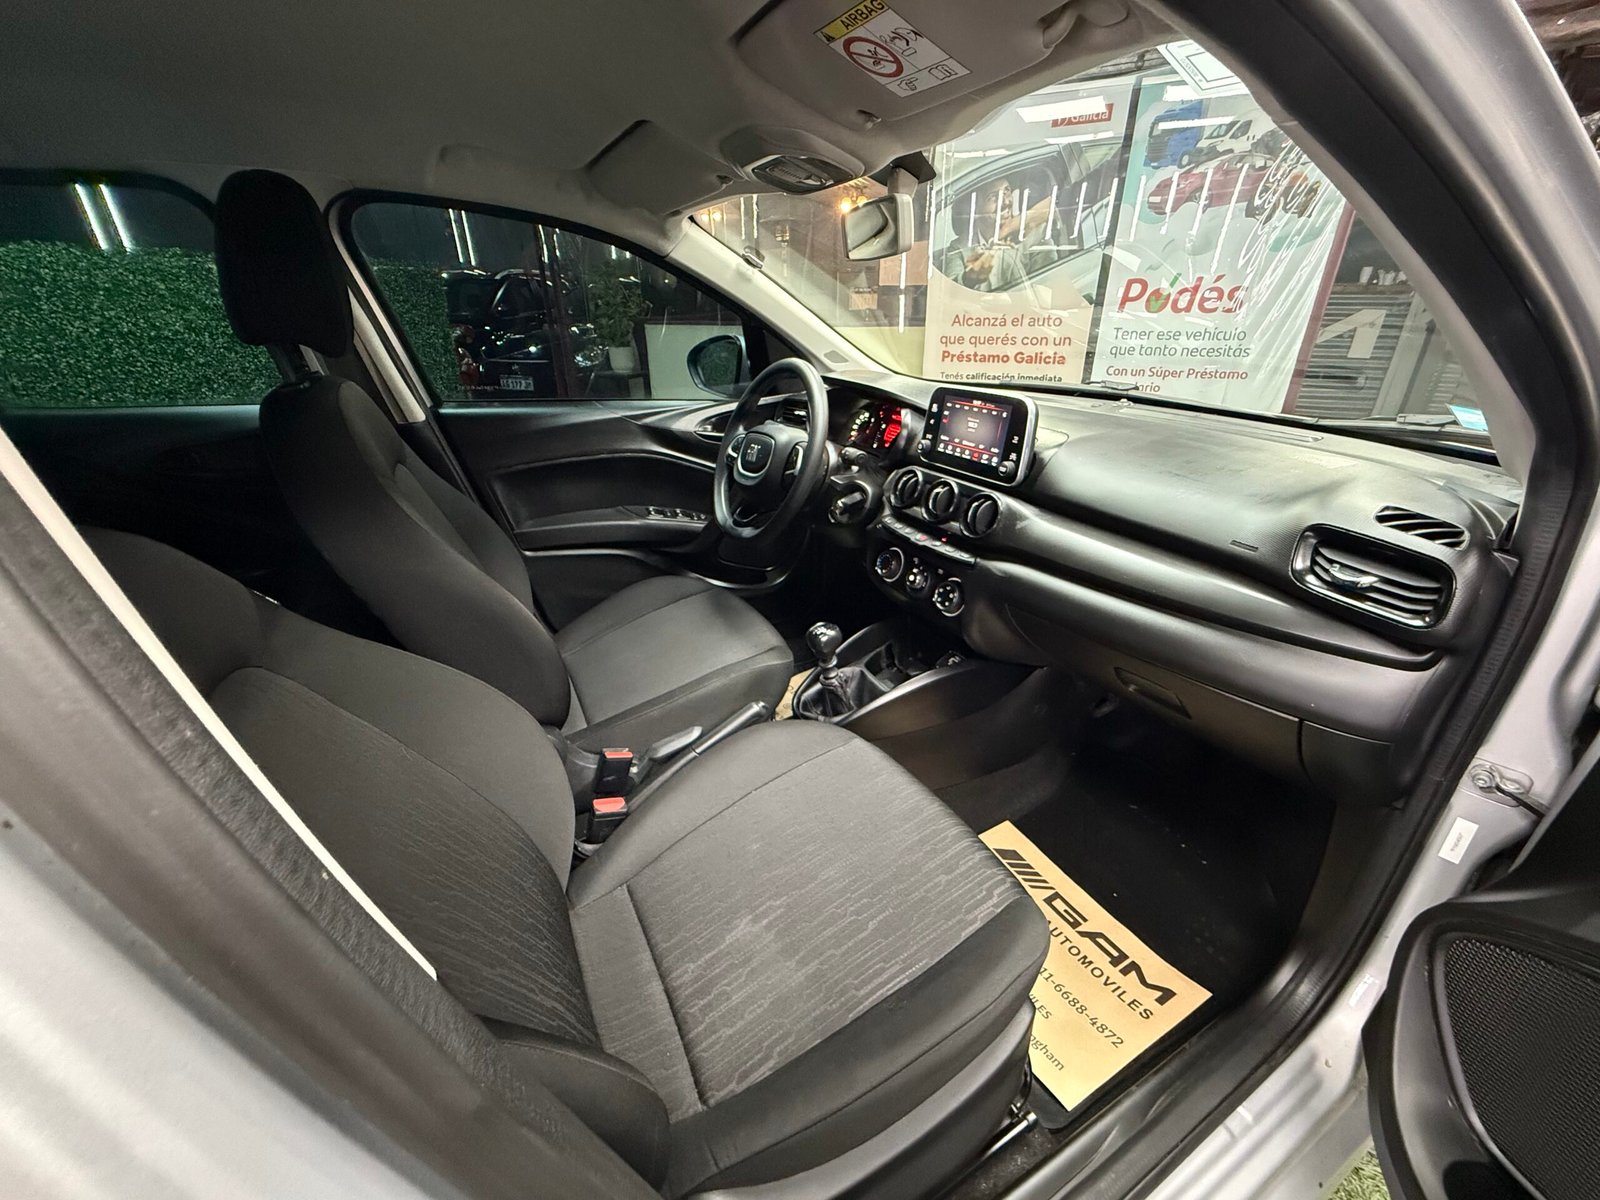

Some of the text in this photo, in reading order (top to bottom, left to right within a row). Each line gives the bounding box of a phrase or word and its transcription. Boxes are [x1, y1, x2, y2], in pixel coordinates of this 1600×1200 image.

[840, 0, 885, 30] AIRBAG
[1117, 273, 1248, 314] Podés
[951, 314, 1063, 327] Alcanzá el auto
[940, 333, 1072, 348] que querés con un
[1114, 327, 1154, 341] Tener
[1156, 330, 1181, 341] ese
[941, 350, 1066, 365] Préstamo Galicia
[1110, 344, 1251, 358] que tanto necesitás
[940, 371, 964, 380] Tenés
[1106, 365, 1248, 380] Con un Súper Préstamo
[1136, 382, 1161, 392] ario
[1043, 891, 1177, 1006] GAM
[1047, 920, 1154, 1020] UTOMOVILES
[1030, 1034, 1065, 1071] ngham
